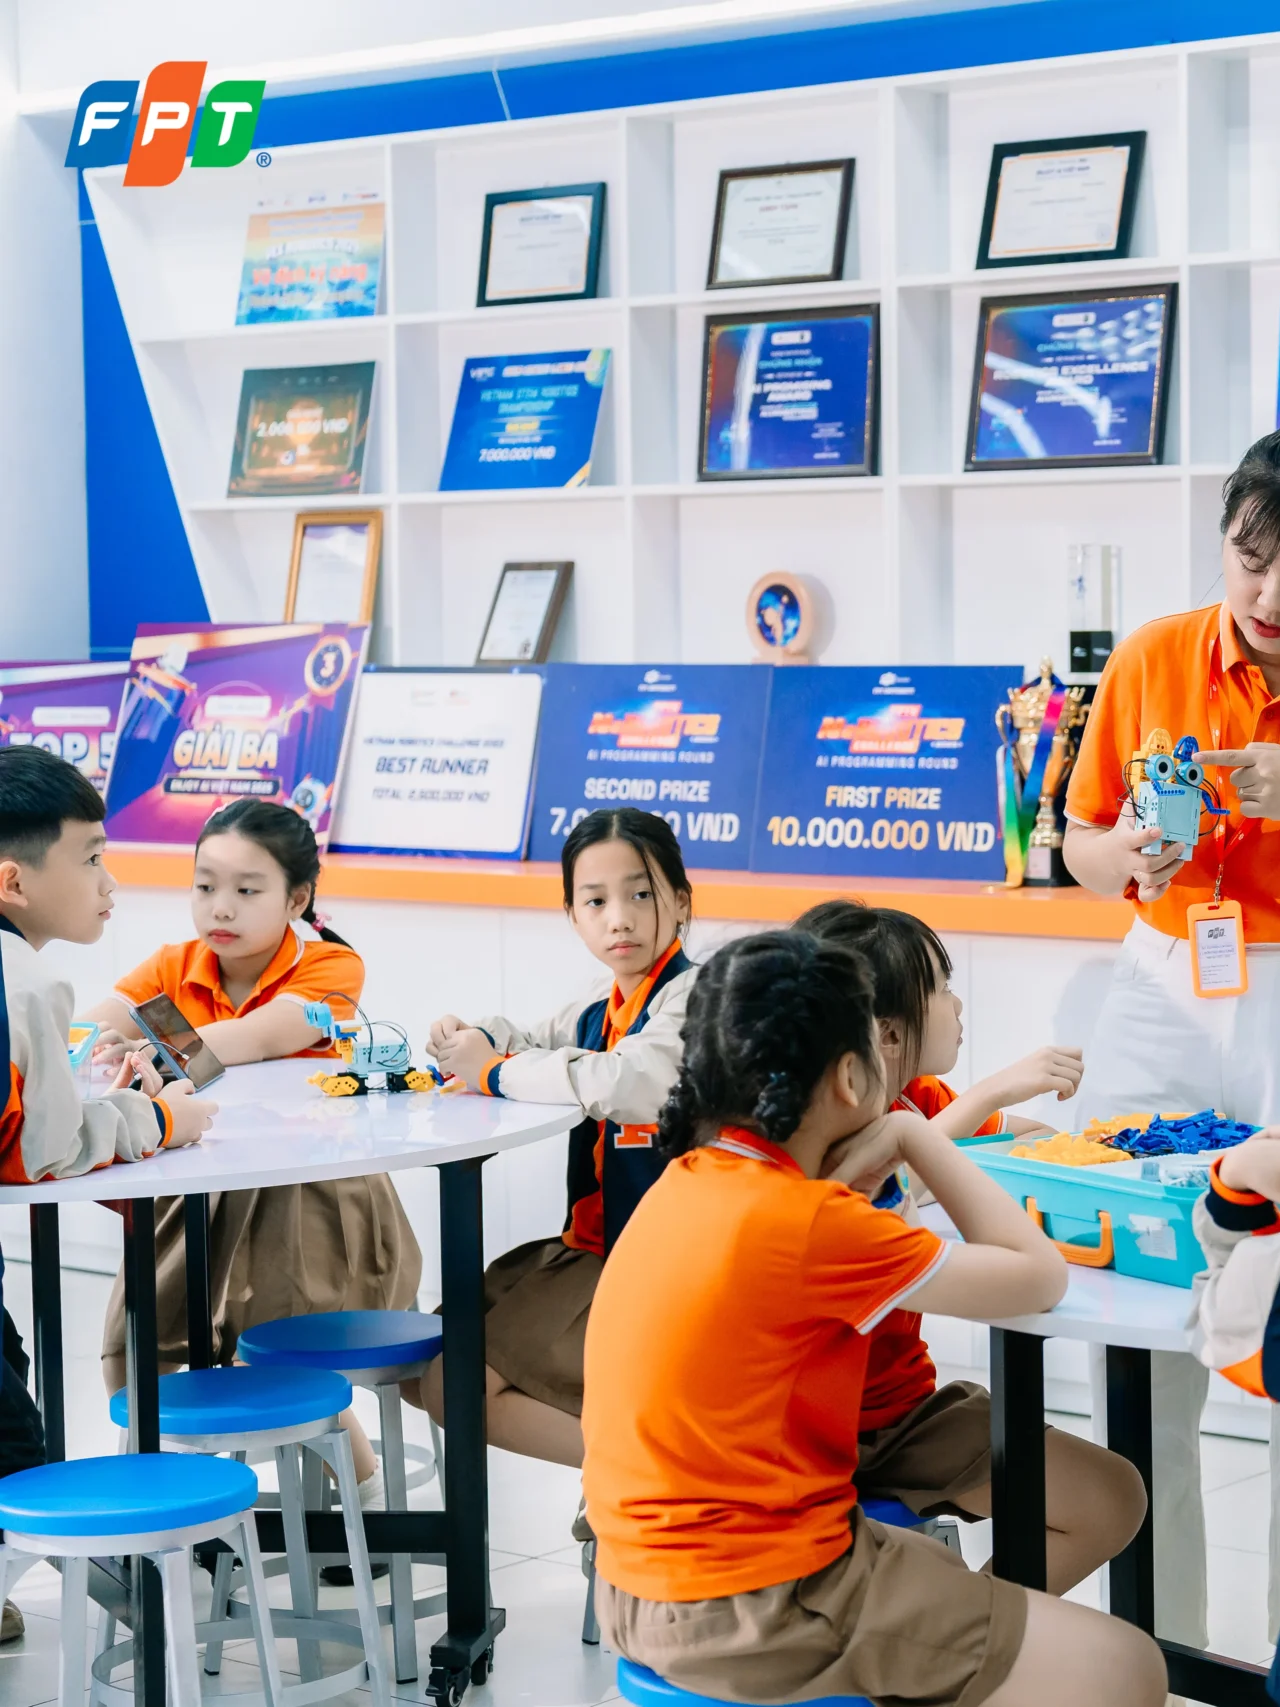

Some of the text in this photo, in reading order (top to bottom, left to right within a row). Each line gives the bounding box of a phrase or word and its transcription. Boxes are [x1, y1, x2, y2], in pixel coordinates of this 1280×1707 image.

[320, 651, 338, 679] 3
[173, 722, 280, 770] GIẢI BA
[586, 749, 715, 764] AI PROGRAMMING ROUND
[375, 757, 489, 775] BEST RUNNER
[816, 755, 959, 770] AI PROGRAMMING ROUND
[584, 777, 711, 803] SECOND PRIZE
[825, 785, 943, 810] FIRST PRIZE
[686, 812, 740, 842] VND
[767, 815, 996, 853] 10.000.000 VND
